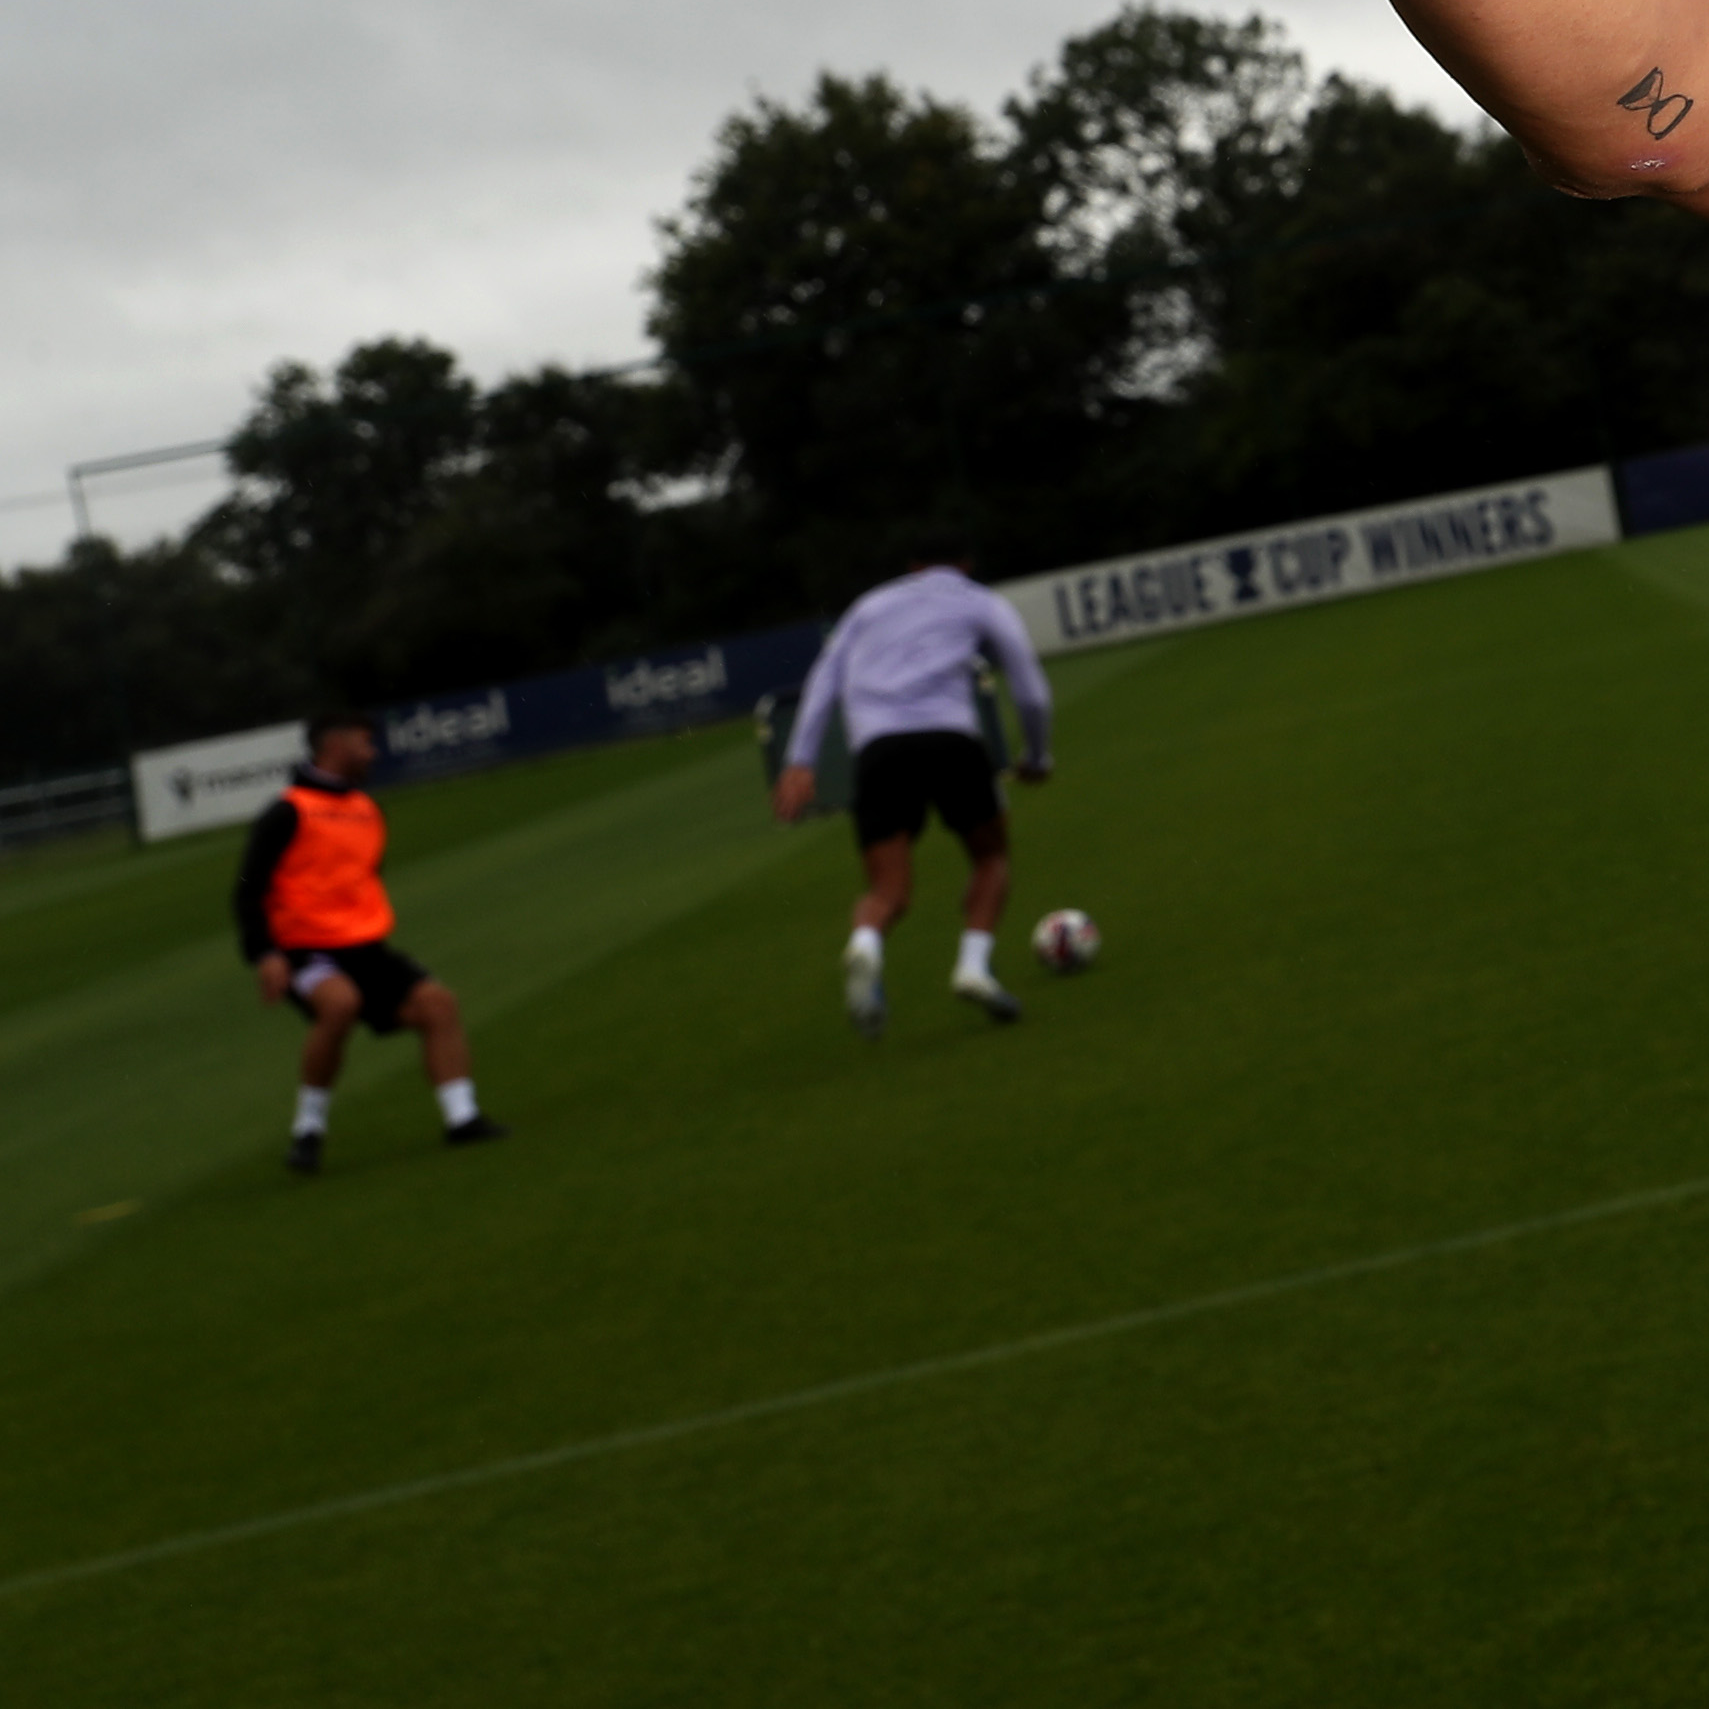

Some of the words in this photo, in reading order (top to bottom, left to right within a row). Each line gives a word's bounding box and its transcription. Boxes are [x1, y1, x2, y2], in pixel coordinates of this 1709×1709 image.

[1055, 552, 1216, 640] LEAGUE
[1267, 528, 1352, 595] CUP
[1361, 489, 1554, 571] WINNERS
[604, 647, 728, 709] ideal
[385, 686, 511, 756] ideal
